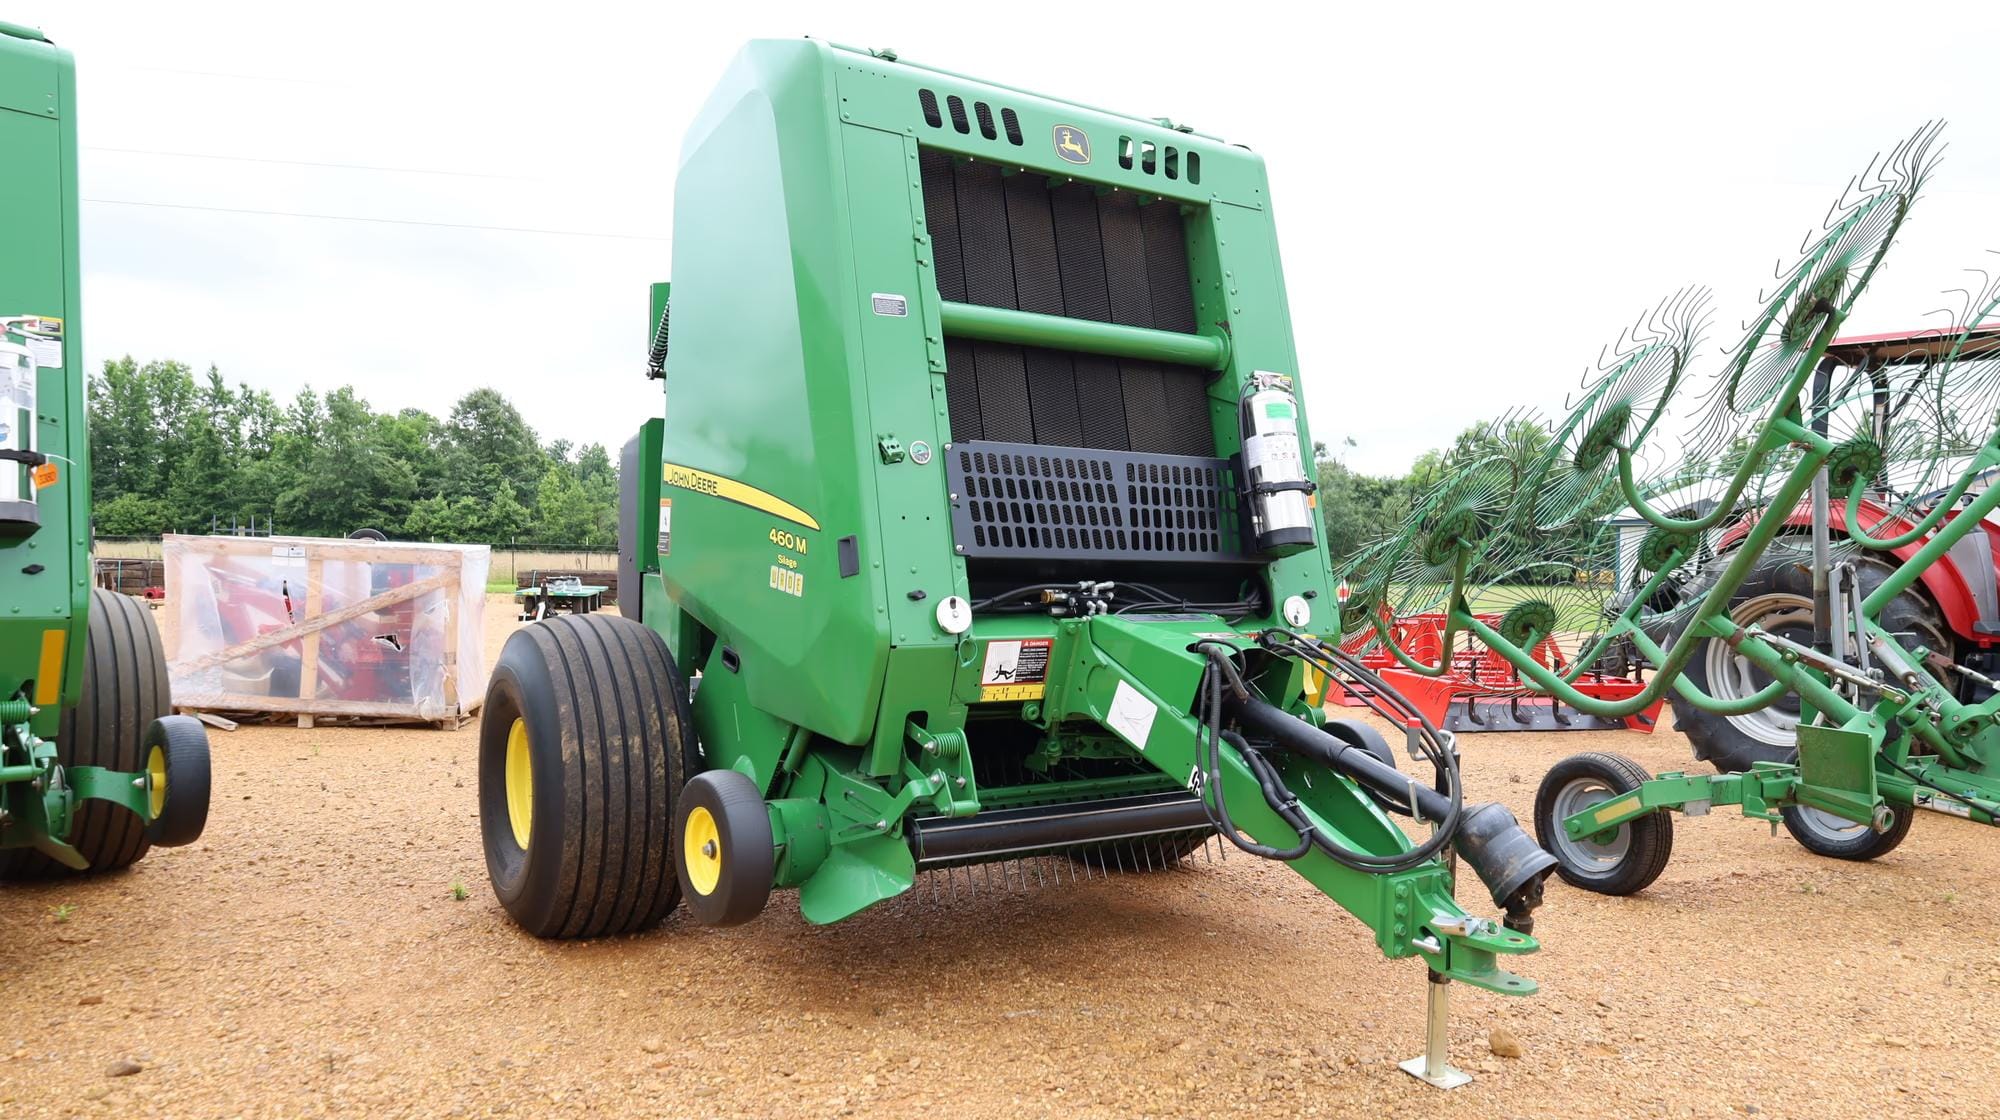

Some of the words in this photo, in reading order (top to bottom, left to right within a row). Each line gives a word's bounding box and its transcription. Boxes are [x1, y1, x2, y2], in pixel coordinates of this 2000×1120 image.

[669, 469, 690, 487] JOHN
[690, 472, 718, 495] DEERE
[769, 528, 794, 550] 460
[796, 535, 807, 555] M
[777, 555, 798, 568] Silage
